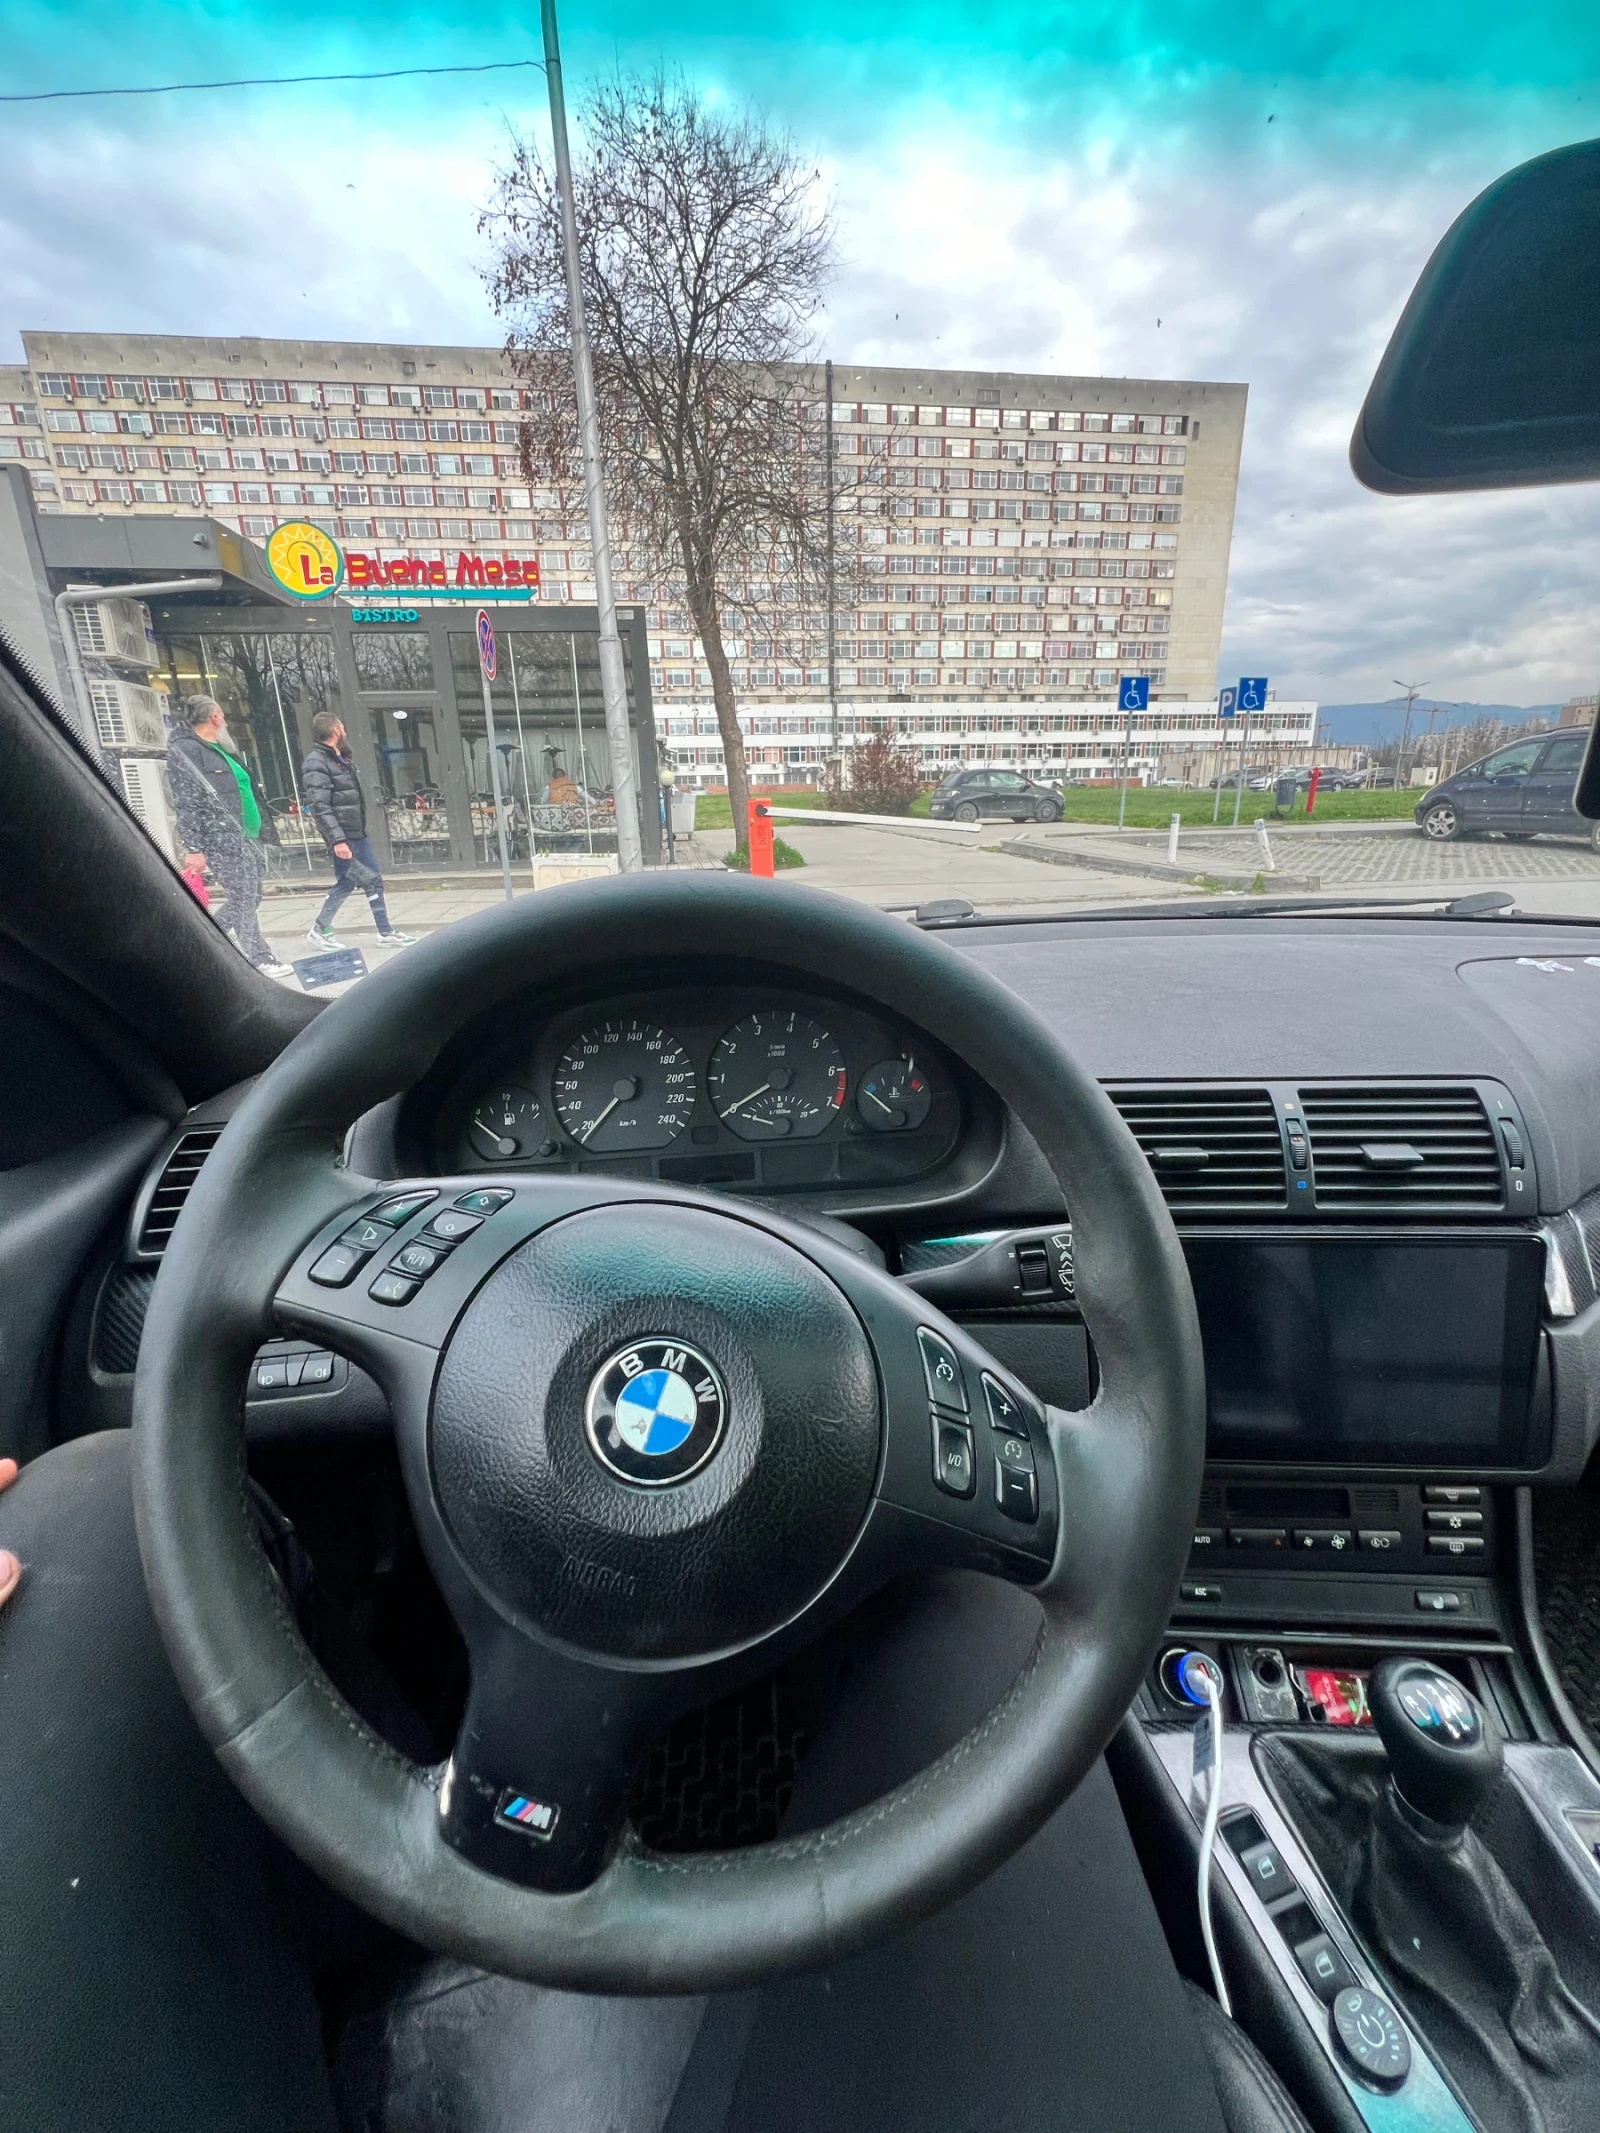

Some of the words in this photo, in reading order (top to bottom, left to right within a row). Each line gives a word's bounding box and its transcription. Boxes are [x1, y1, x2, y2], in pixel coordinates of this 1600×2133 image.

[300, 554, 335, 586] La
[345, 553, 447, 587] Buena
[455, 551, 541, 587] Mesa
[352, 609, 419, 624] BISTRO
[1220, 690, 1233, 716] P
[754, 1025, 762, 1036] 3
[786, 1024, 794, 1033] 4
[603, 1033, 619, 1043] 120
[626, 1032, 643, 1042] 140
[645, 1040, 662, 1051] 160
[728, 1043, 737, 1054] 2
[812, 1038, 819, 1049] 5
[583, 1044, 599, 1054] 100
[571, 1060, 585, 1070] 80
[659, 1055, 676, 1065] 180
[828, 1066, 836, 1077] 6
[665, 1073, 685, 1083] 200
[720, 1073, 725, 1084] 1
[565, 1080, 578, 1090] 60
[666, 1093, 684, 1104] 220
[826, 1097, 834, 1107] 7
[568, 1100, 582, 1110] 40
[657, 1114, 676, 1124] 240
[581, 1120, 595, 1130] 20
[406, 1252, 426, 1267] R/T
[618, 1348, 717, 1403] BMW
[1194, 1536, 1211, 1544] AUTO
